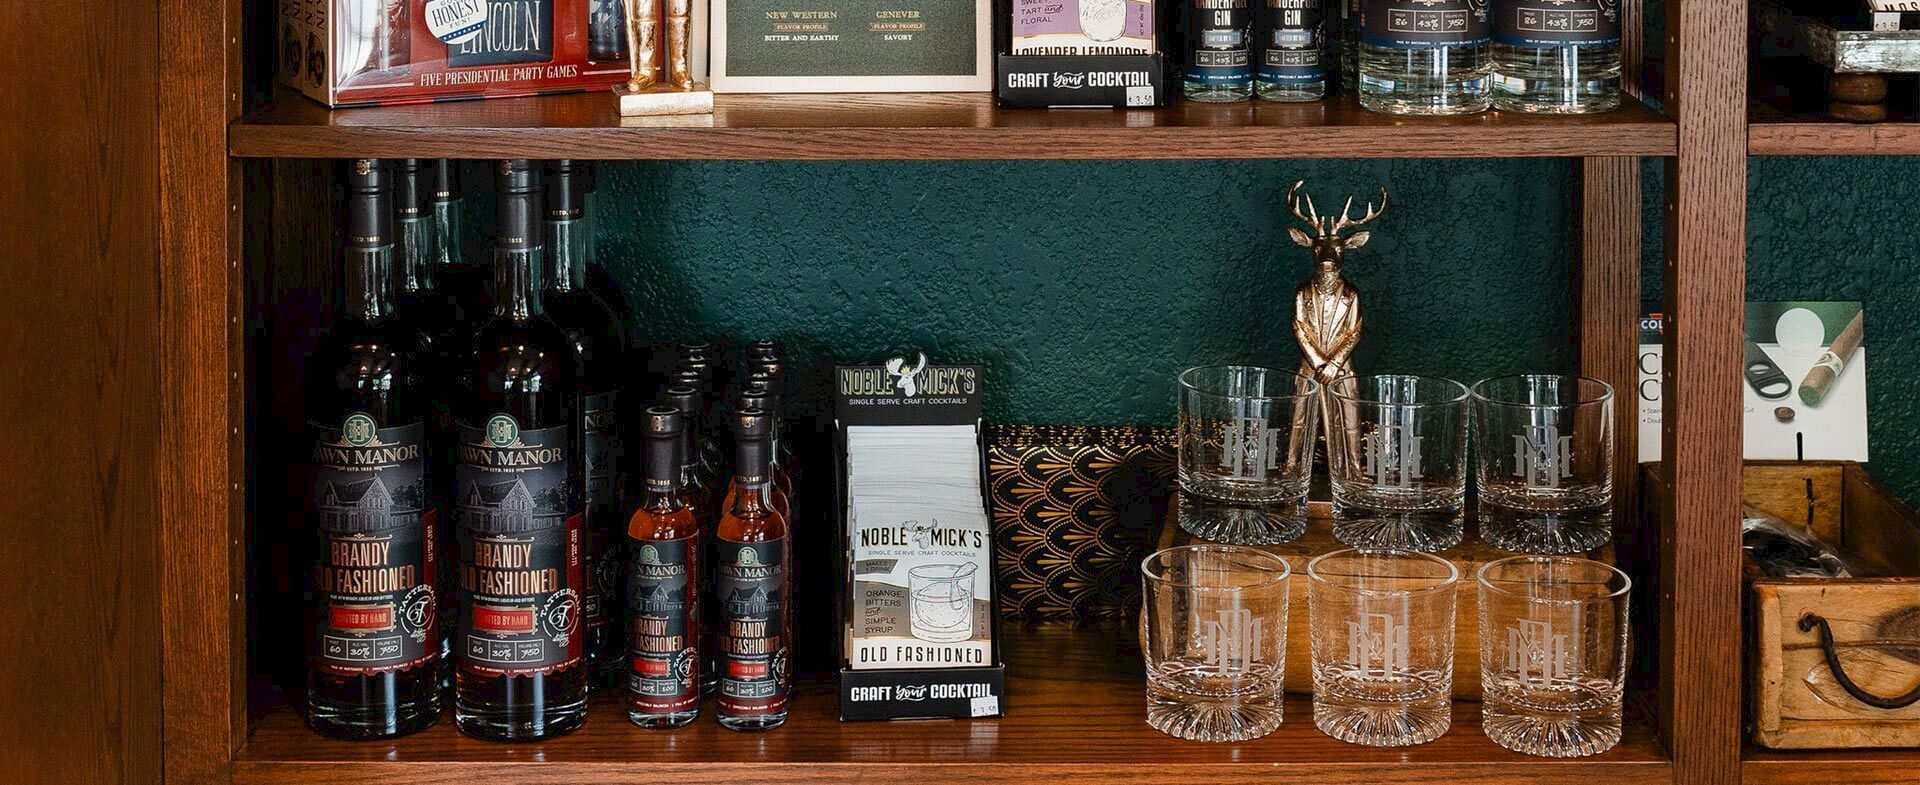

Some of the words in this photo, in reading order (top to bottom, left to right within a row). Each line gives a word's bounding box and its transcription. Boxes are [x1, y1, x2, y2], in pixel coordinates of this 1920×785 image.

[432, 0, 479, 27] HONEST
[792, 11, 838, 19] WESTERN
[1021, 8, 1041, 16] TART
[1044, 3, 1063, 14] and
[1284, 10, 1301, 25] GIN
[1021, 16, 1052, 25] FLORAL
[1214, 10, 1231, 26] GIN
[1395, 18, 1408, 26] 86
[1418, 19, 1439, 30] 43%
[1447, 19, 1464, 29] 750
[1524, 17, 1537, 25] 86
[1546, 18, 1568, 29] 43%
[1576, 18, 1594, 28] 750
[461, 0, 540, 54] NCOLN
[420, 73, 441, 87] FIVE
[445, 69, 510, 85] PRESIDENTIAL
[513, 66, 544, 81] PARTY
[547, 64, 578, 79] GAMES
[1008, 72, 1049, 88] CRAFT
[1053, 72, 1084, 89] your
[1088, 71, 1151, 87] COCKTAIL
[840, 368, 894, 396] NOBLE
[917, 368, 976, 395] MICK'S
[928, 397, 967, 405] COCKTAILS
[355, 444, 419, 464] MANOR
[497, 448, 562, 466] MANOR
[861, 527, 907, 547] NOBLE
[931, 528, 982, 548] MICK'S
[332, 542, 390, 568] BRANDY
[475, 543, 532, 568] BRANDY
[647, 565, 685, 576] MANOR
[745, 565, 781, 577] MANOR
[337, 565, 415, 594] FASHIONED
[480, 568, 558, 595] FASHIONED
[540, 588, 580, 617] TATTERSALL
[866, 590, 905, 599] ORANGE,
[360, 612, 369, 623] BY
[370, 612, 386, 623] HAND
[865, 607, 881, 617] and
[502, 615, 511, 626] BY
[511, 615, 528, 625] HAND
[865, 617, 896, 625] SIMPLE
[730, 621, 767, 637] BRANDY
[636, 635, 683, 652] ASHIONED
[733, 635, 780, 654] FASHIONED
[861, 647, 887, 663] OLD
[896, 646, 982, 664] FASHIONED
[850, 686, 892, 702] CRAFT
[895, 684, 927, 701] your
[930, 683, 992, 699] COCKTAIL
